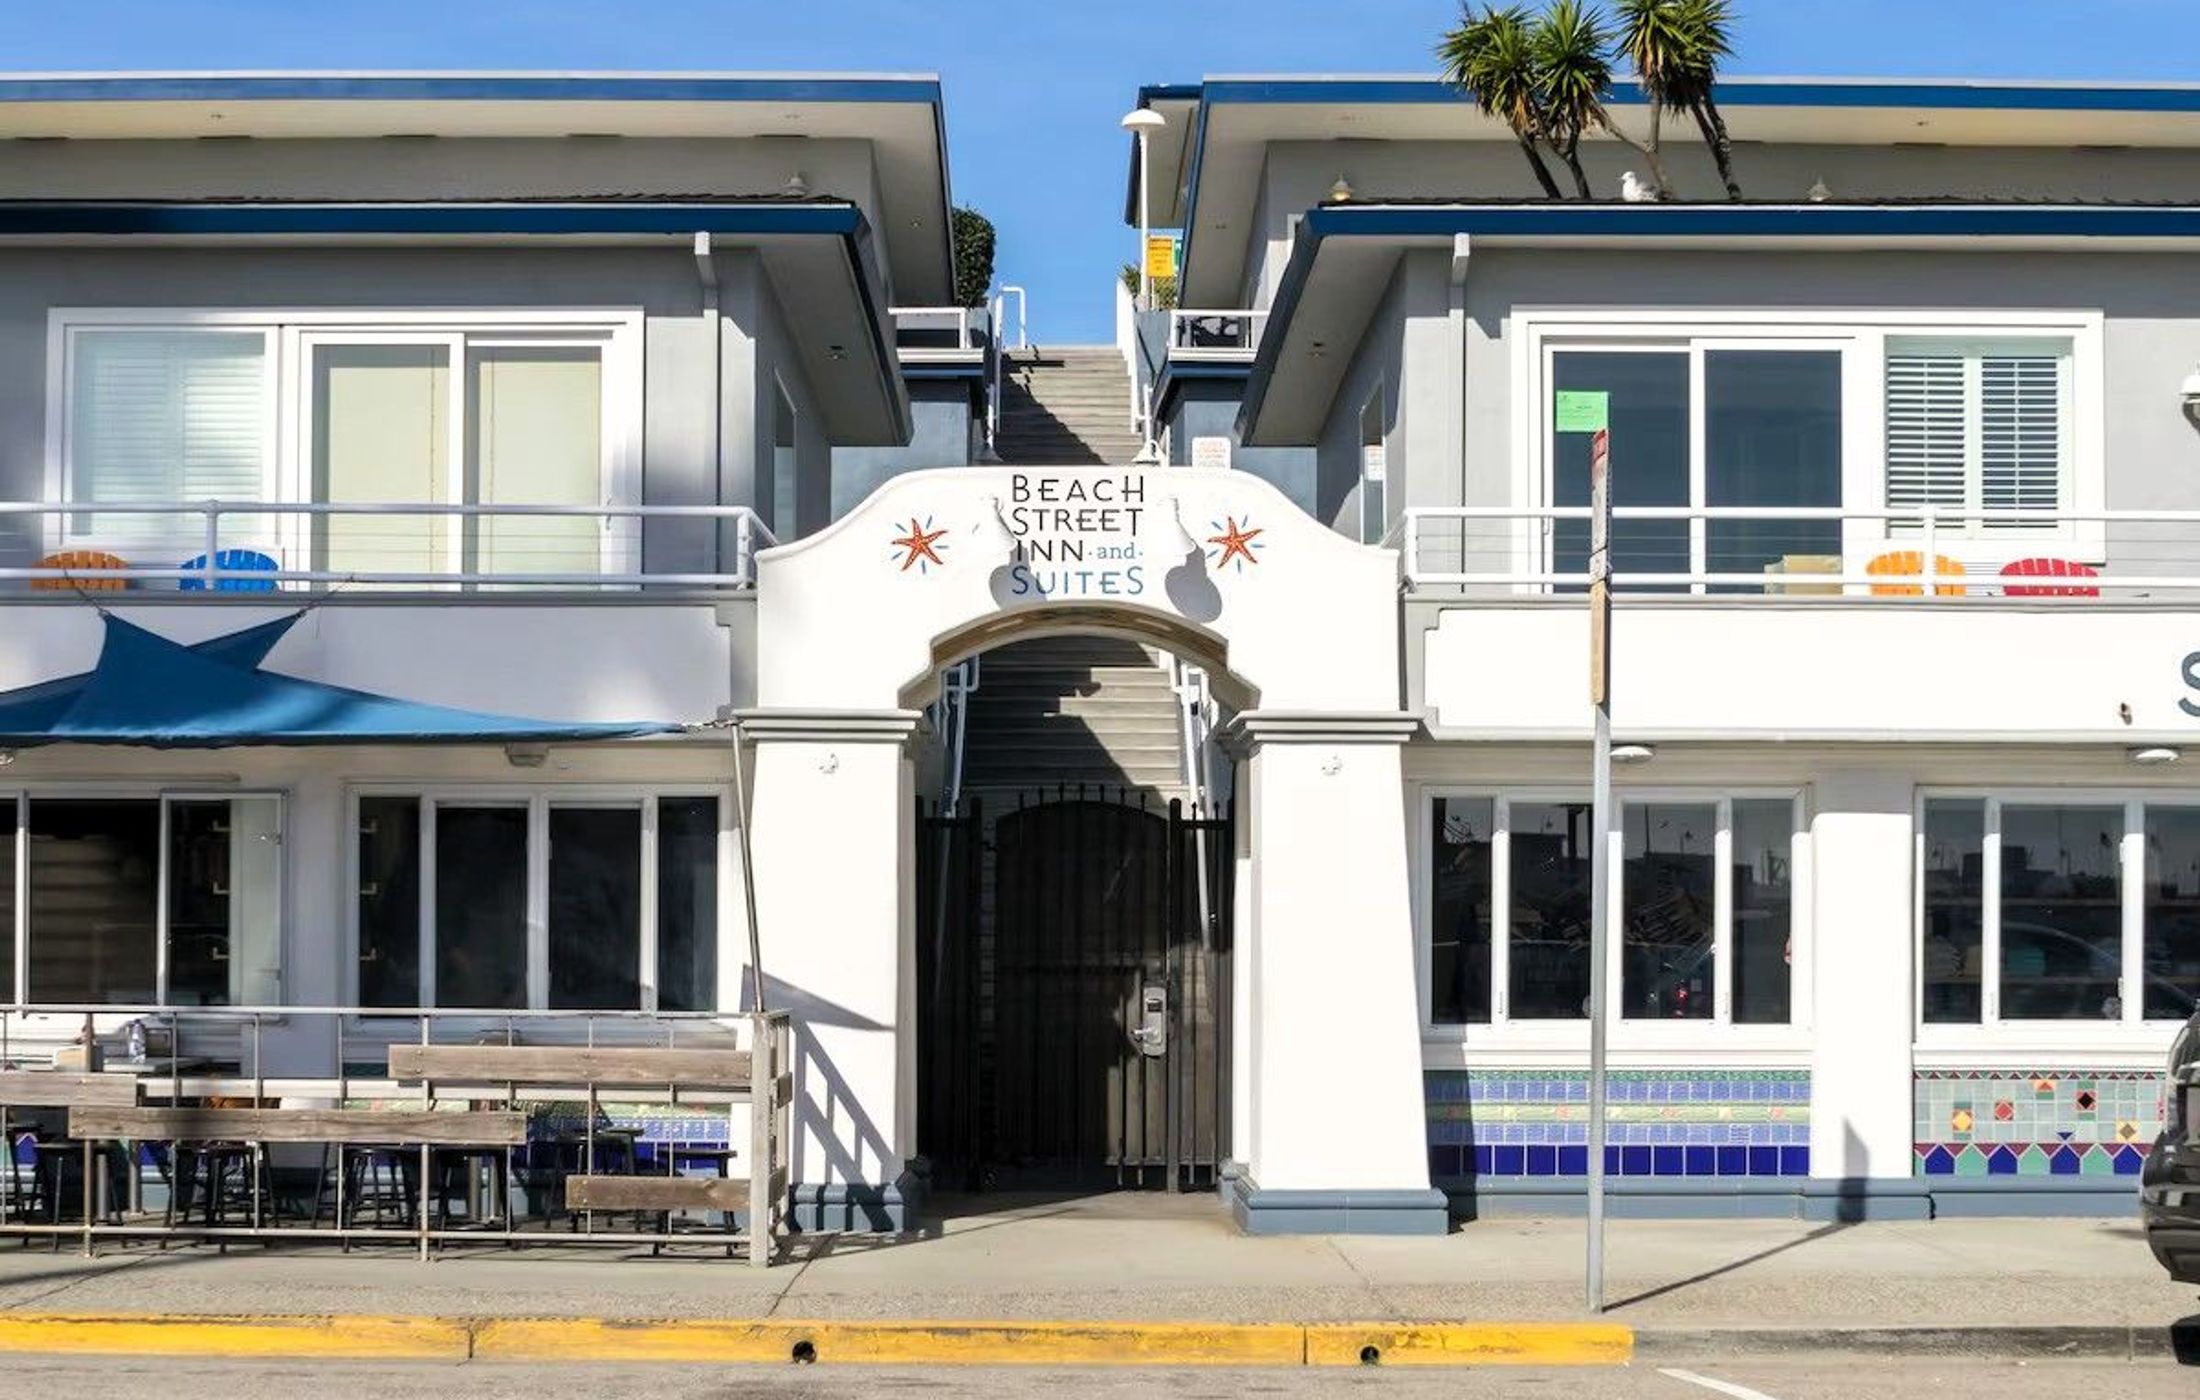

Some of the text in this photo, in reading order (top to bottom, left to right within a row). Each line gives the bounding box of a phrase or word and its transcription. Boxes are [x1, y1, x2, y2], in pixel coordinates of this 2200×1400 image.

[1012, 474, 1143, 502] BEACH
[1012, 507, 1143, 537] STREET
[1017, 539, 1083, 562] INN
[1012, 566, 1144, 595] SUITES
